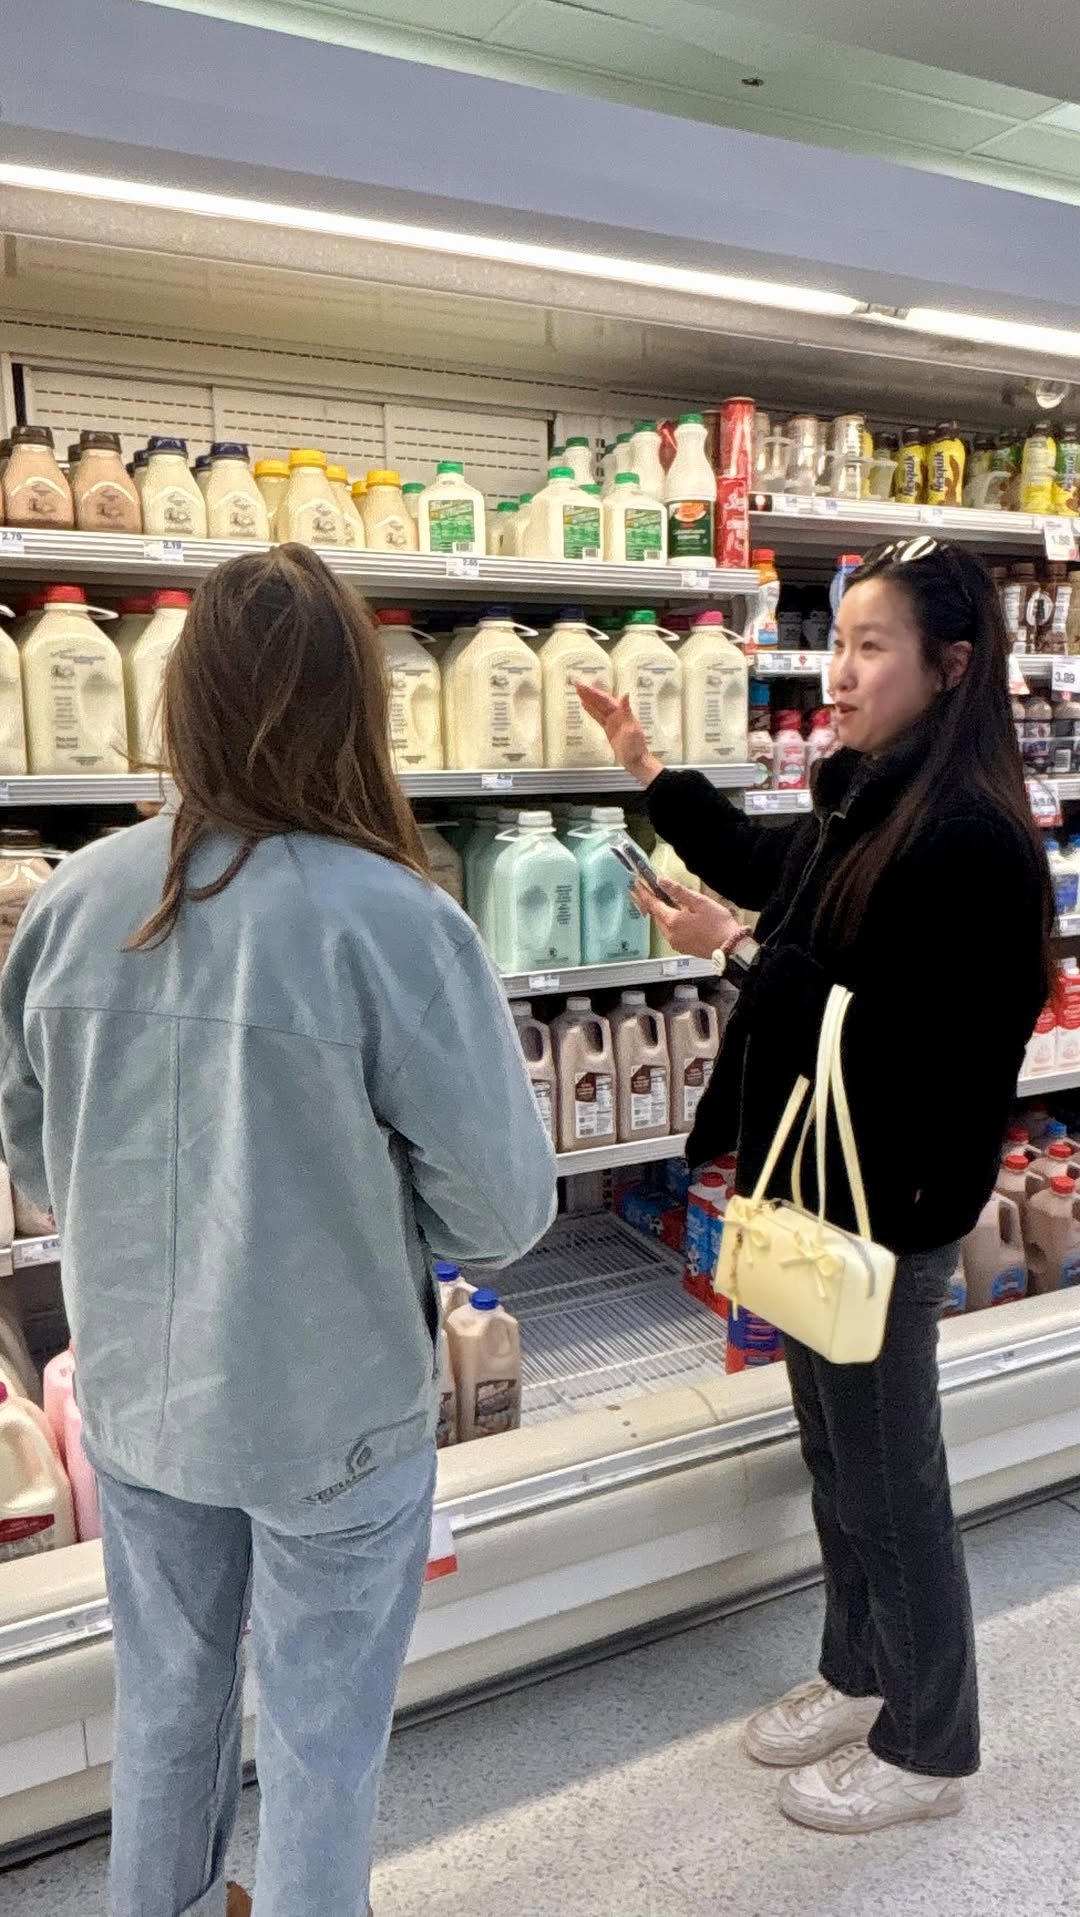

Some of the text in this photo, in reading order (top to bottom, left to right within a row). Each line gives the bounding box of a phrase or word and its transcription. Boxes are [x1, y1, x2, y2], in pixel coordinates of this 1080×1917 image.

[904, 455, 918, 497] Nesquik
[934, 451, 948, 493] Nesquik
[2, 531, 22, 541] 2.79
[1055, 671, 1076, 684] 3.89
